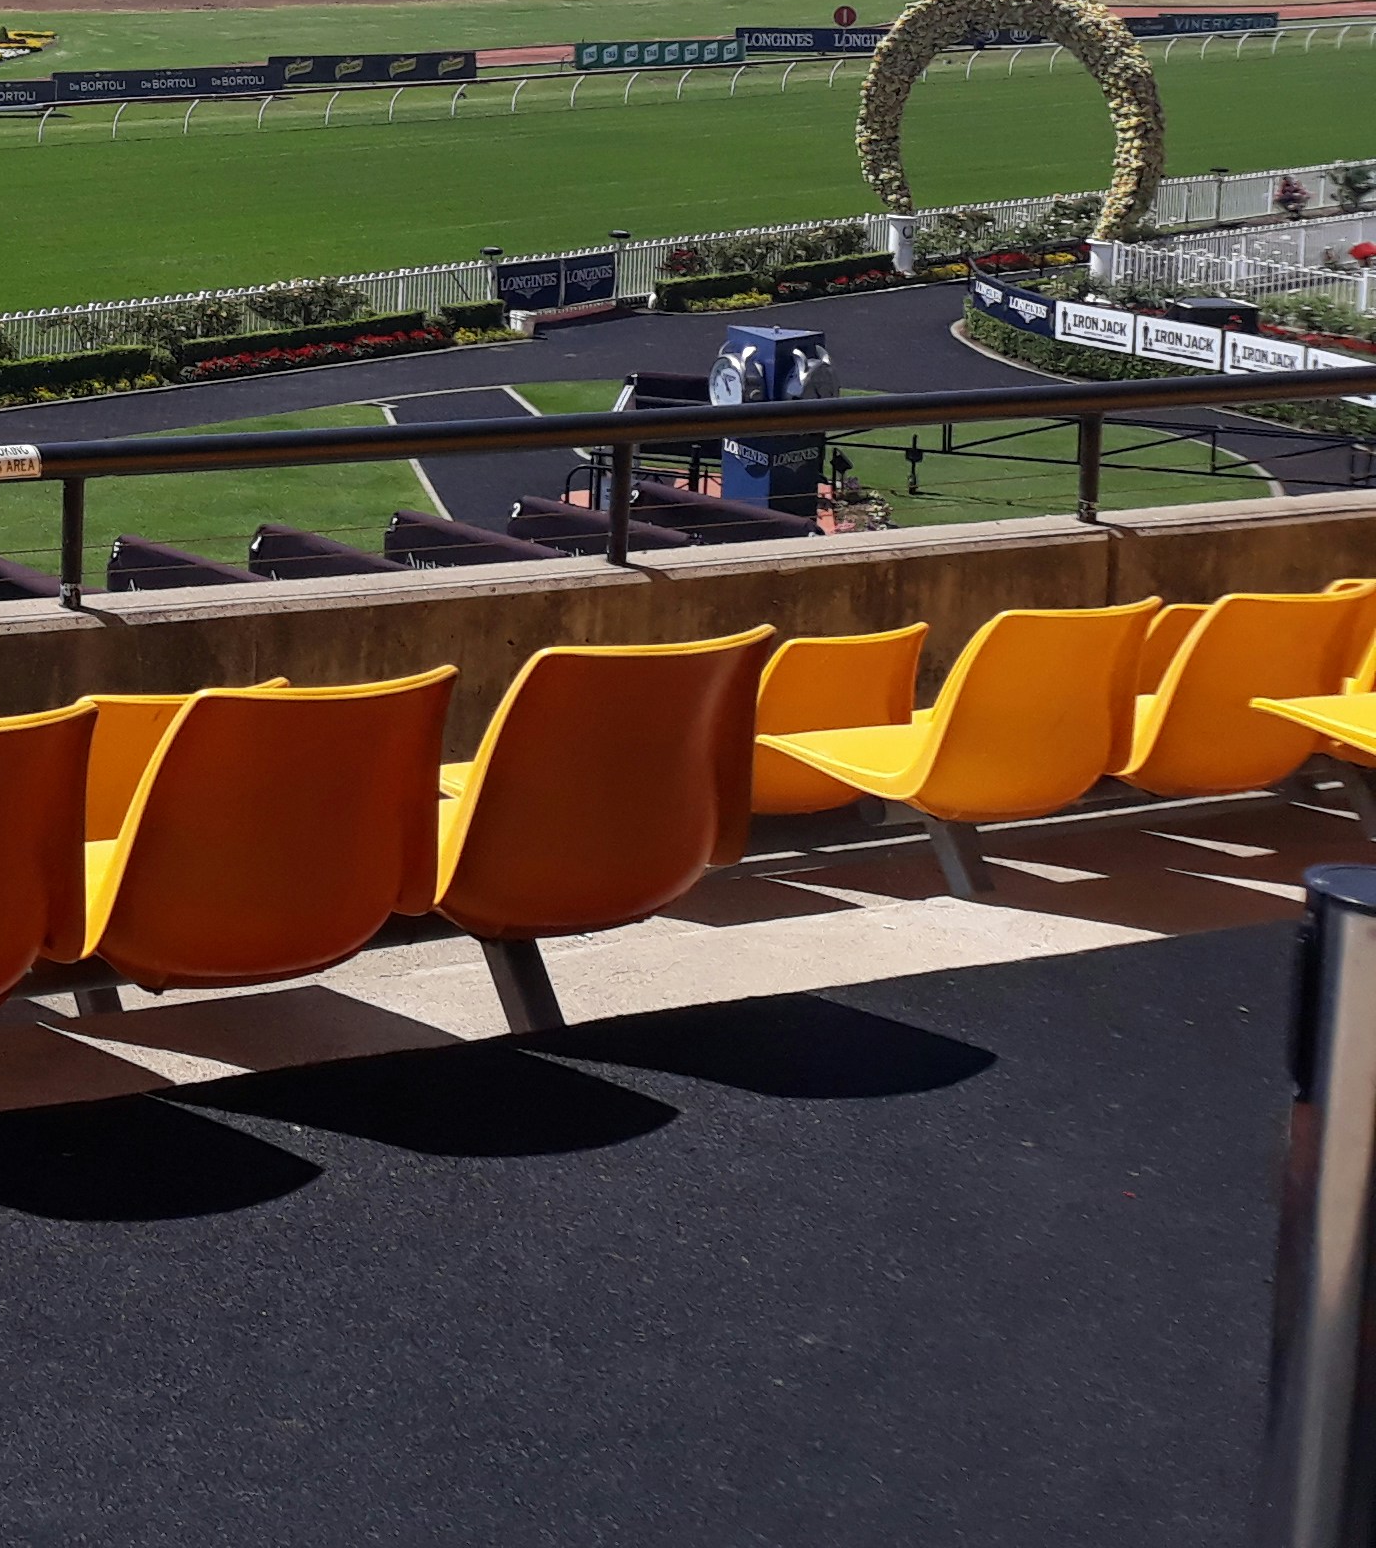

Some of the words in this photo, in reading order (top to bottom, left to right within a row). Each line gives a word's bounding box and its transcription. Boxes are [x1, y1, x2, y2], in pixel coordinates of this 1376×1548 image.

[744, 32, 814, 47] LONGINES
[80, 80, 126, 92] BORTOLI
[152, 78, 196, 90] BORTOLI
[221, 75, 265, 87] BORTOLI
[500, 272, 559, 292] LONGINES
[566, 264, 614, 284] LONGINES
[1072, 313, 1099, 332] IRON
[1100, 319, 1128, 337] JACK
[1154, 328, 1182, 346] IRON
[1185, 334, 1215, 353] JACK
[1241, 345, 1269, 363] IRON
[1269, 351, 1299, 370] JACK
[723, 437, 769, 467] LONGINES
[772, 446, 820, 467] LONGINES
[6, 458, 35, 472] AREA
